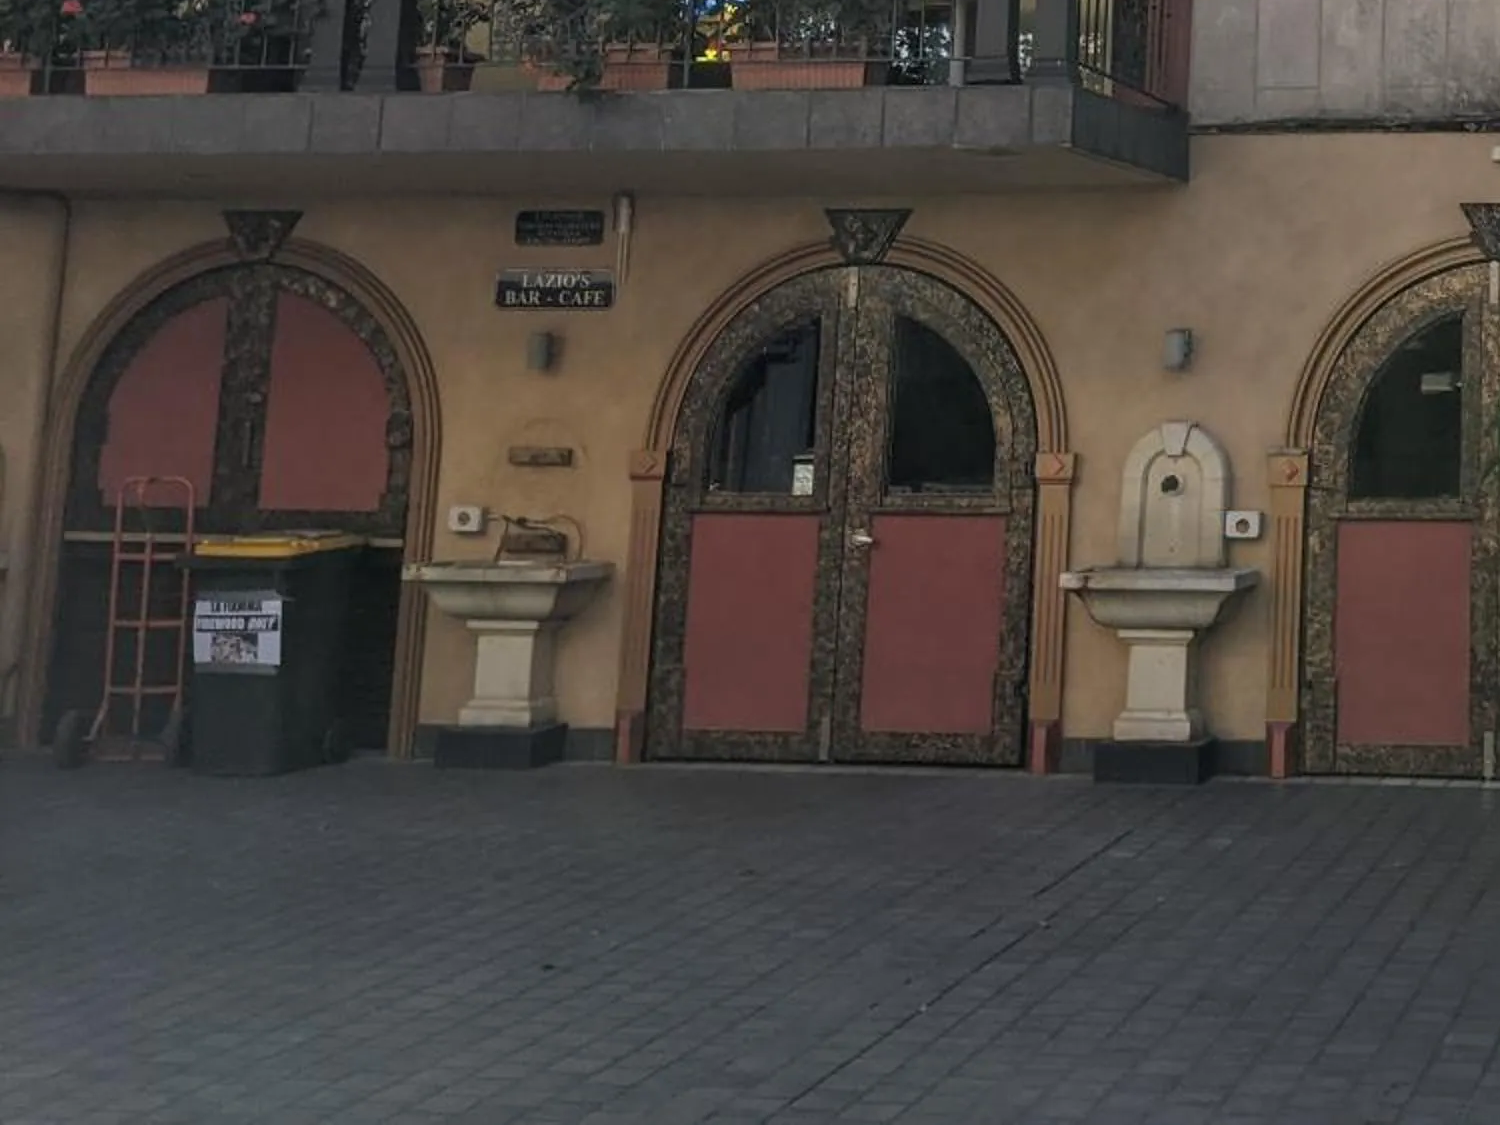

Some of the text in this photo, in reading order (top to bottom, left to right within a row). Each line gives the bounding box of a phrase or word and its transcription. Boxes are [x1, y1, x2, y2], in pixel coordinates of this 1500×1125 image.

[523, 274, 590, 288] LAZIO'S
[505, 290, 540, 305] BAR
[559, 290, 605, 305] CAFE
